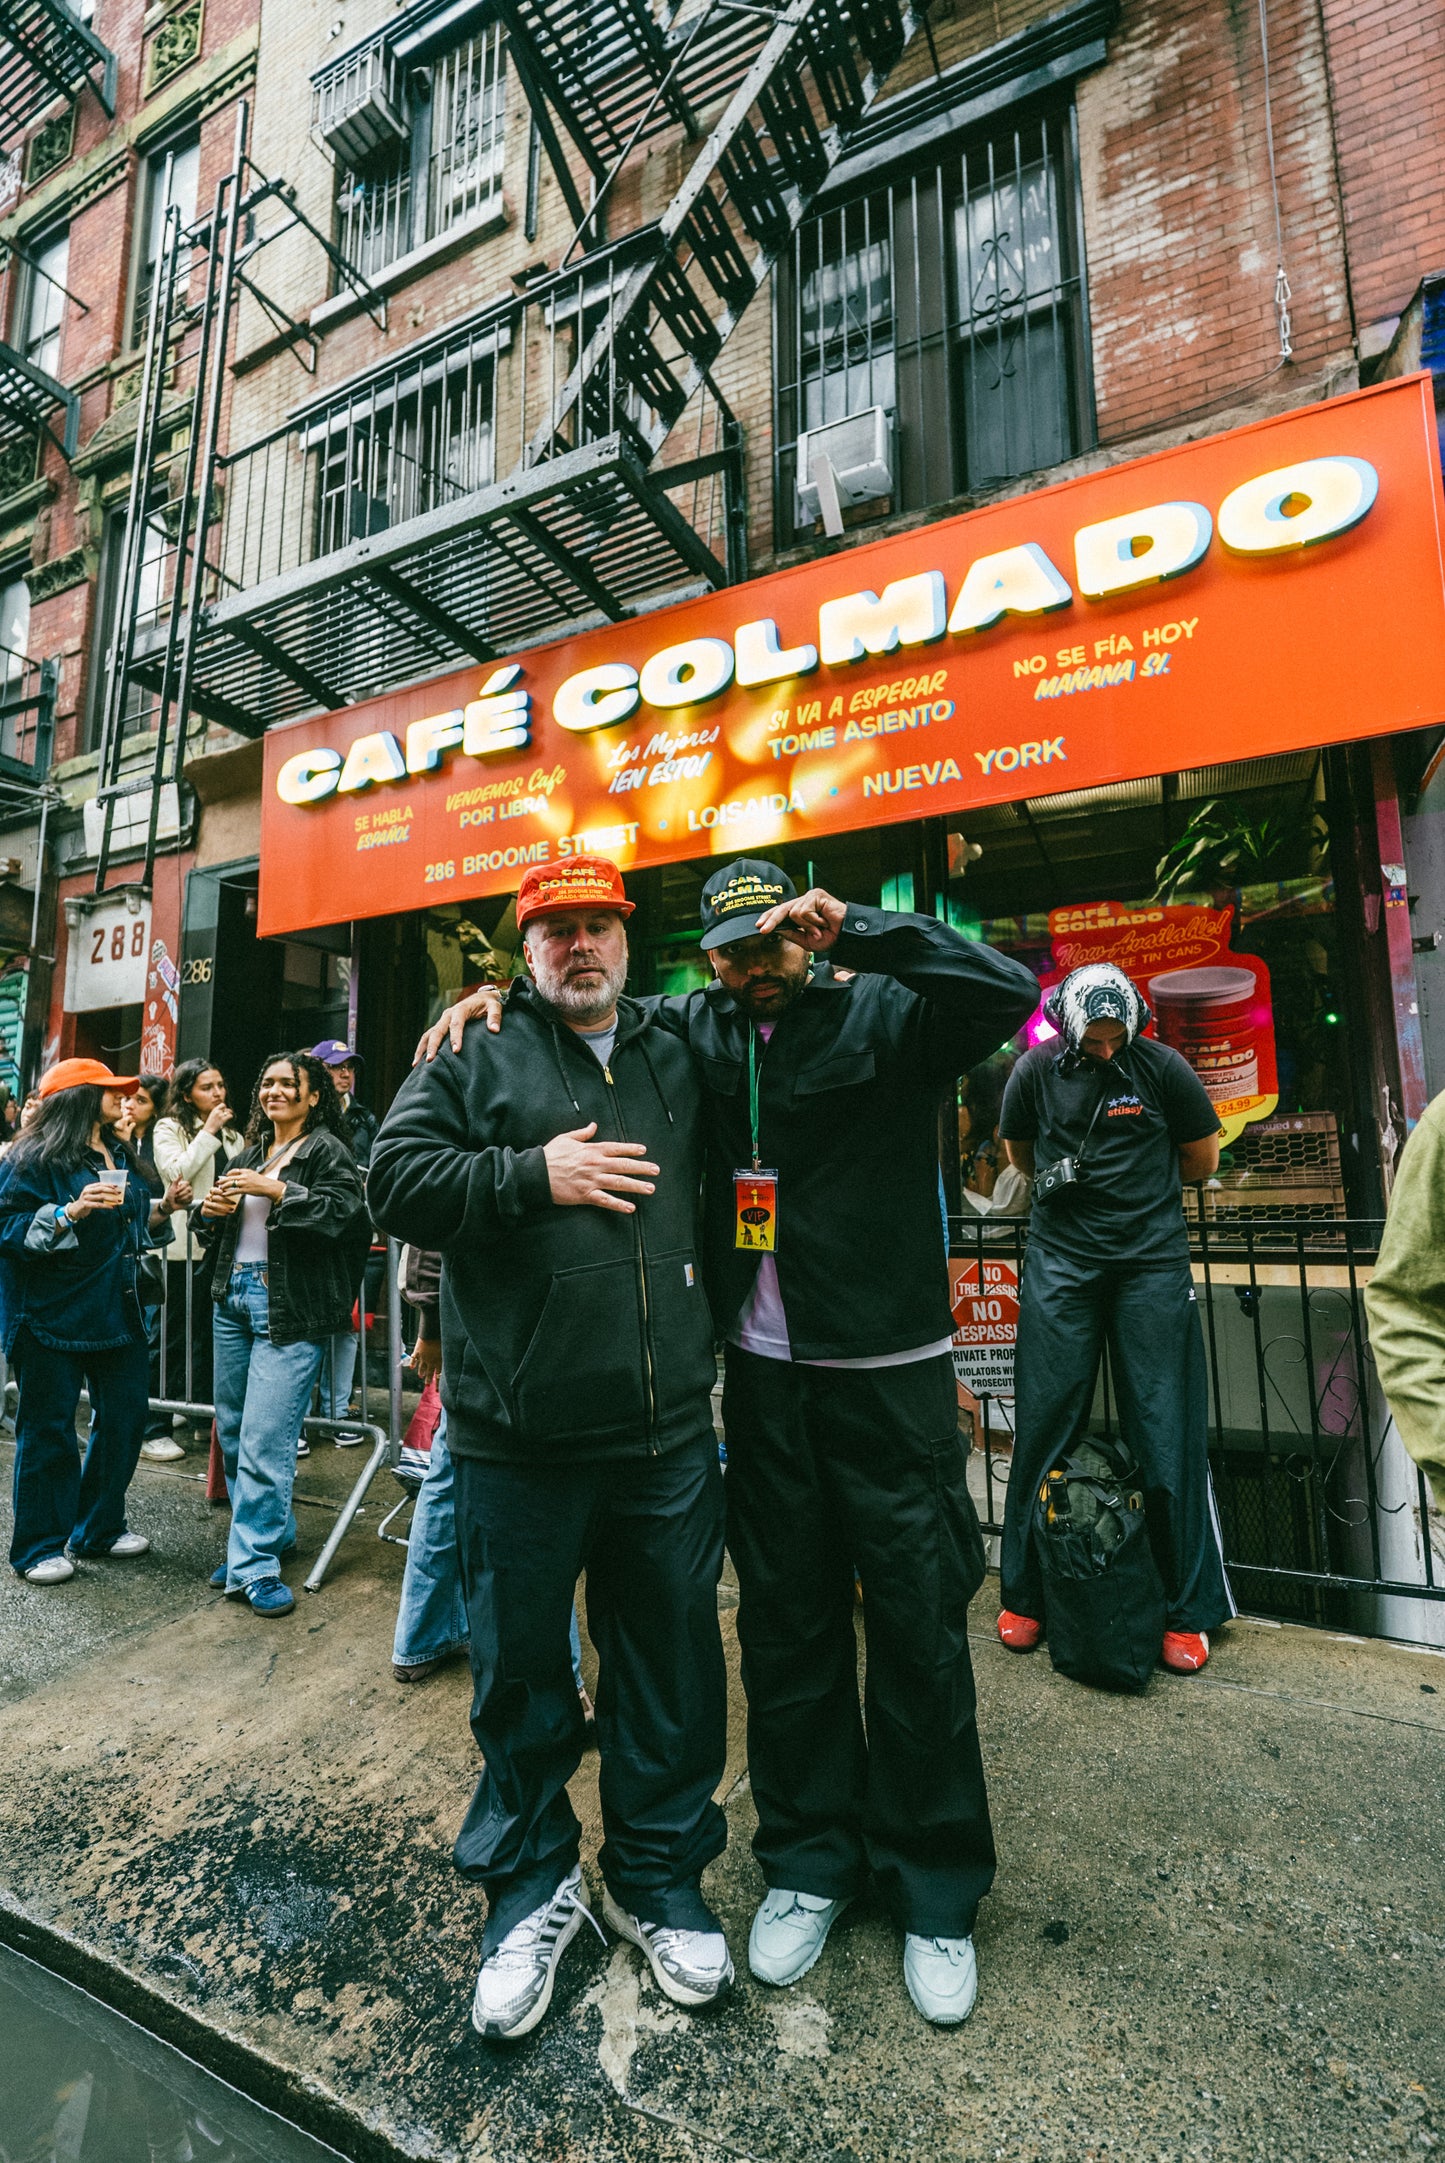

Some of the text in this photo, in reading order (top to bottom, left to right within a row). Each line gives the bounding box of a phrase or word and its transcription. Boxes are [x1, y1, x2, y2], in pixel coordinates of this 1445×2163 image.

[276, 455, 1379, 805] CAFÉ COLMADO
[1013, 617, 1199, 678] NO SE FÍA HOY
[1034, 659, 1136, 701] MAÑANA
[768, 670, 947, 731] SI VA A ESPERAR
[767, 699, 955, 759] TOME ASIENTO
[607, 725, 720, 768] Los Mejores
[608, 766, 648, 793] ¡EN
[446, 777, 524, 813] VENDEMOS
[355, 805, 413, 832] SE HABLA
[424, 736, 1067, 883] 286 BROOME STREET LOISAIDA NUEVA YORK
[460, 793, 549, 829] POR LIBRA
[356, 825, 410, 851] ESPAÑOL
[561, 866, 596, 876] CAFÉ
[728, 875, 762, 888] CAFÉ
[539, 877, 613, 891] COLMADO
[711, 884, 783, 906] COLMADO
[1055, 902, 1110, 922] CAFÉ
[1055, 911, 1165, 933] COLMADO
[90, 920, 145, 965] 288
[1056, 909, 1231, 970] Now Available!
[1143, 951, 1162, 964] TIN
[1166, 943, 1202, 958] CANS
[181, 957, 213, 985] 286
[1184, 1040, 1231, 1053] CAFÉ
[1193, 1048, 1255, 1069] MADO
[1107, 1104, 1143, 1117] stüssy
[746, 1210, 766, 1222] VIP
[983, 1266, 1002, 1281] NO
[958, 1282, 1018, 1296] TREPASSIN
[972, 1300, 1002, 1321] NO
[952, 1324, 1018, 1342] RESPASSI
[952, 1348, 1015, 1362] RIVATE PROP
[957, 1366, 1014, 1377] VIOLATORS WI
[971, 1377, 1015, 1388] PROSECUT
